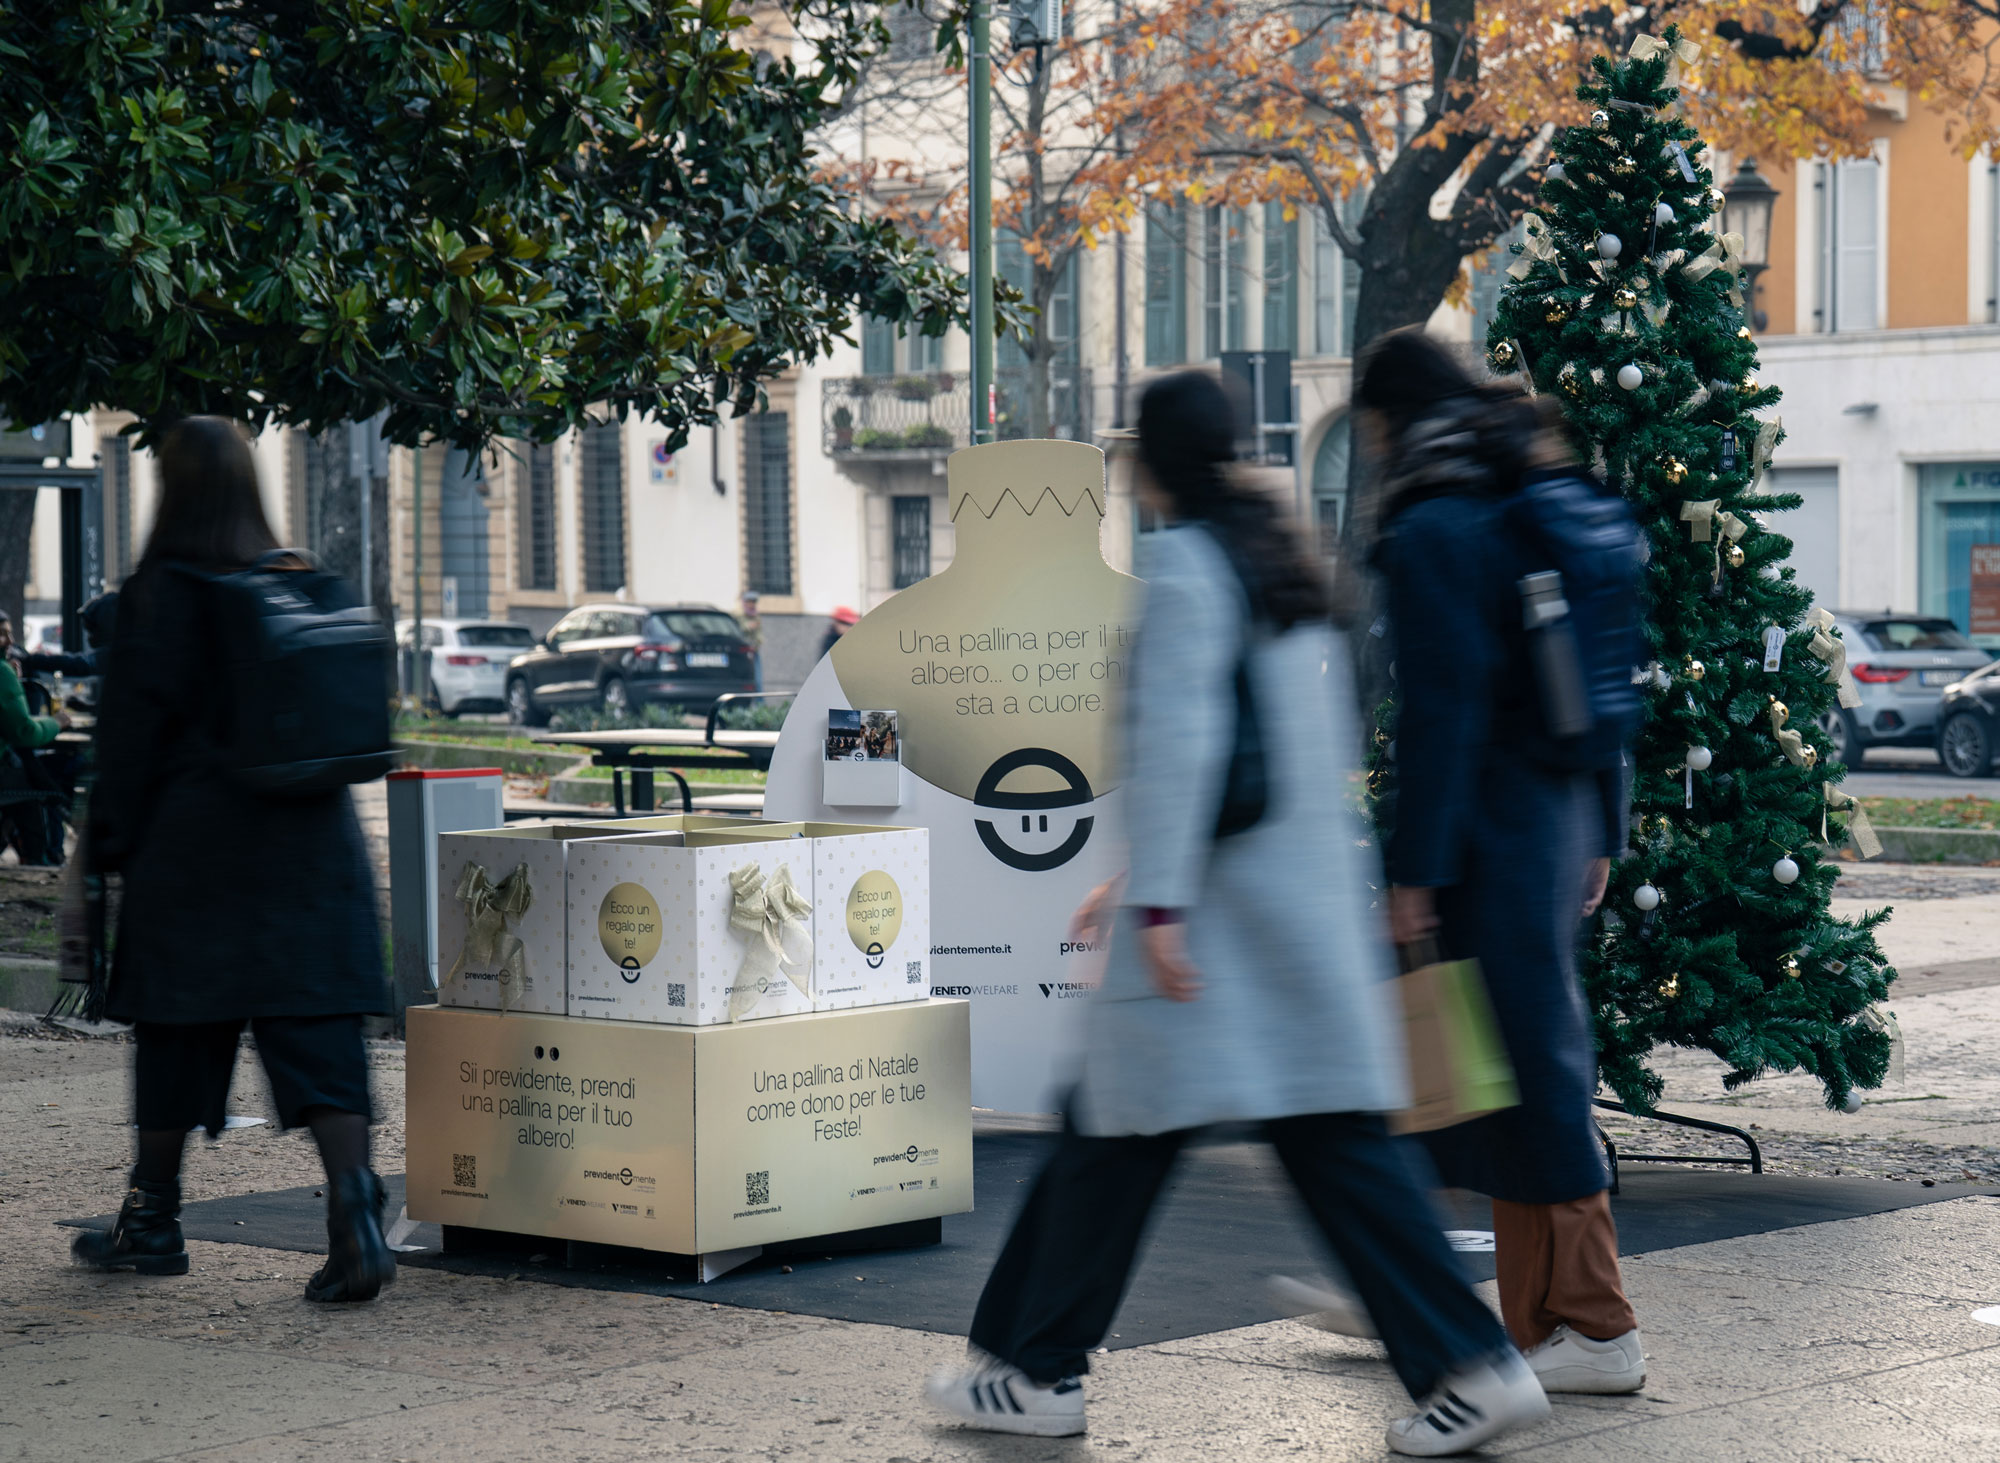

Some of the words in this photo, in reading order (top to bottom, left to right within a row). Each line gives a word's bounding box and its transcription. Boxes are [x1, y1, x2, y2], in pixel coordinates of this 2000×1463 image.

[899, 629, 950, 654] Una
[959, 627, 1039, 658] pallina
[1047, 630, 1090, 656] per
[1099, 624, 1107, 648] il
[911, 661, 1003, 686] albero...
[1012, 664, 1029, 682] o
[1038, 662, 1081, 688] per
[955, 693, 995, 716] sta
[1003, 695, 1020, 715] a
[1028, 693, 1106, 714] cuore.
[857, 890, 879, 903] Ecco
[881, 889, 892, 901] un
[610, 901, 635, 915] Ecco
[637, 904, 650, 915] un
[852, 907, 880, 923] regalo
[881, 906, 896, 920] per
[605, 920, 636, 934] regalo
[638, 922, 655, 935] per
[869, 923, 881, 936] te!
[624, 937, 637, 950] te!
[459, 1060, 477, 1084] Sii
[483, 1066, 575, 1097] previdente,
[581, 1077, 635, 1100] prendi
[754, 1070, 787, 1093] Una
[792, 1063, 844, 1094] pallina
[849, 1059, 863, 1081] di
[868, 1053, 919, 1079] Natale
[462, 1094, 494, 1113] una
[499, 1095, 552, 1120] pallina
[557, 1103, 586, 1126] per
[592, 1102, 598, 1124] il
[604, 1104, 633, 1128] tuo
[747, 1101, 796, 1122] come
[801, 1092, 844, 1115] dono
[850, 1089, 877, 1114] per
[882, 1083, 895, 1104] le
[899, 1082, 926, 1103] tue
[517, 1124, 574, 1150] albero!
[814, 1114, 862, 1142] Feste!
[440, 1188, 489, 1200] previdentemente.it
[733, 1205, 782, 1220] previdentemente.it
